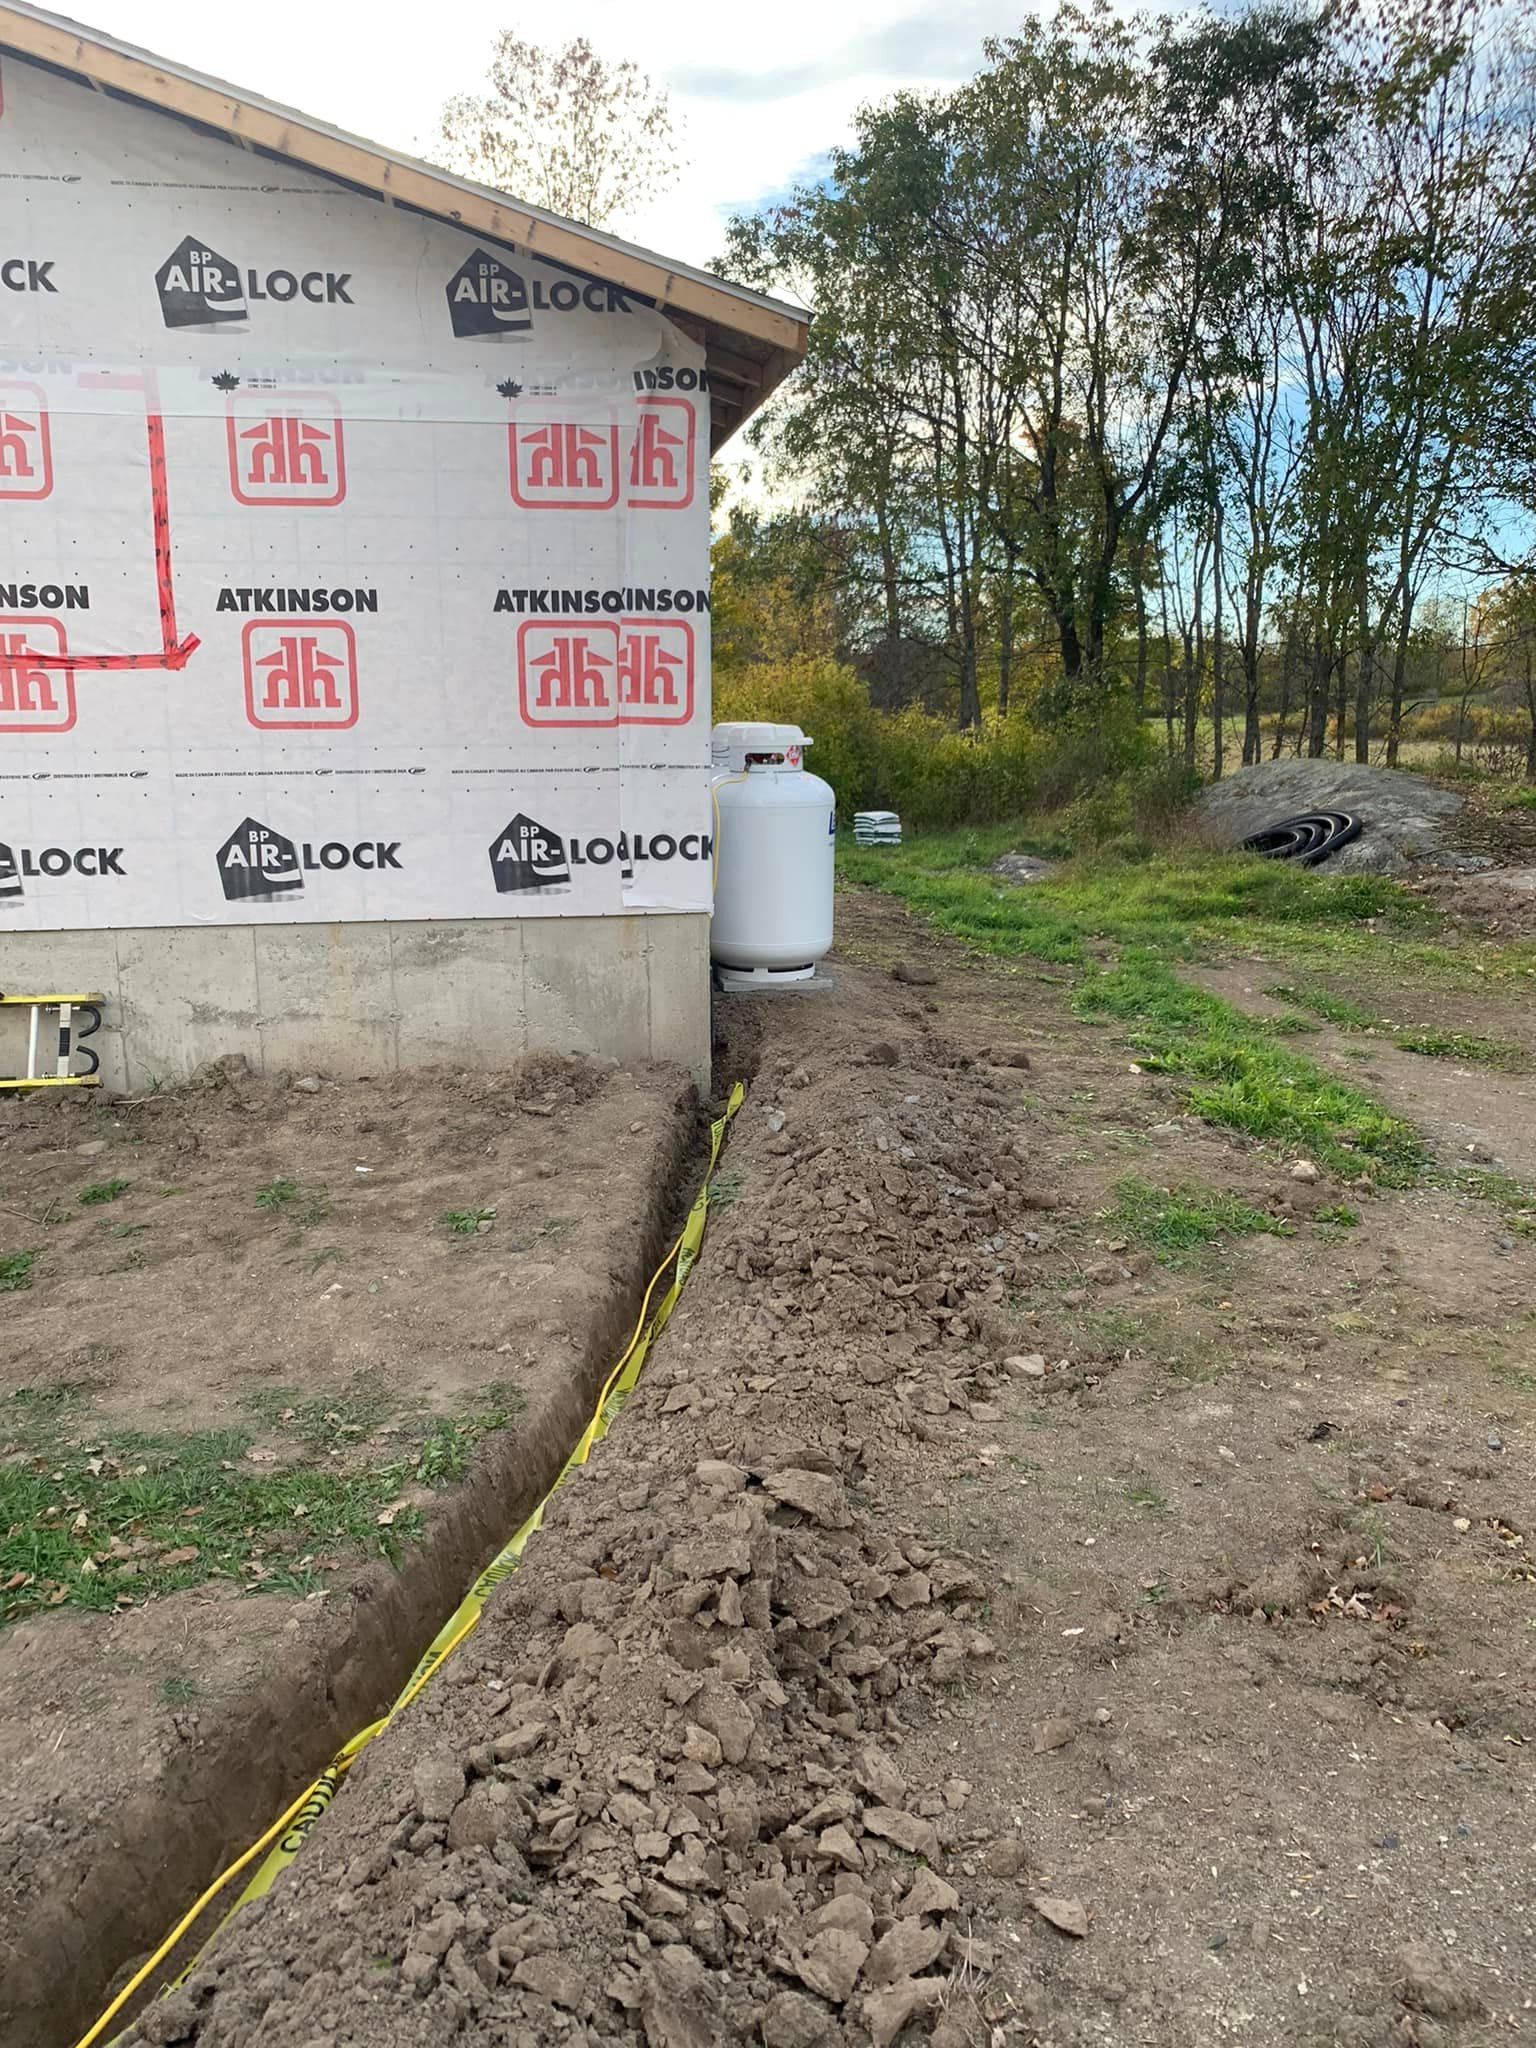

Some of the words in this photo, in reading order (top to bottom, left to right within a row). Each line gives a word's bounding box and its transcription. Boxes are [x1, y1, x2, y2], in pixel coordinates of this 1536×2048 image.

[190, 251, 212, 265] BP
[478, 263, 500, 277] BP
[0, 584, 90, 609] NSON
[215, 588, 378, 612] ATKINSON
[493, 589, 623, 613] ATKINSO
[624, 588, 711, 613] INSON
[249, 831, 270, 843] BP
[520, 826, 539, 837] BP
[634, 833, 712, 862] LOCK
